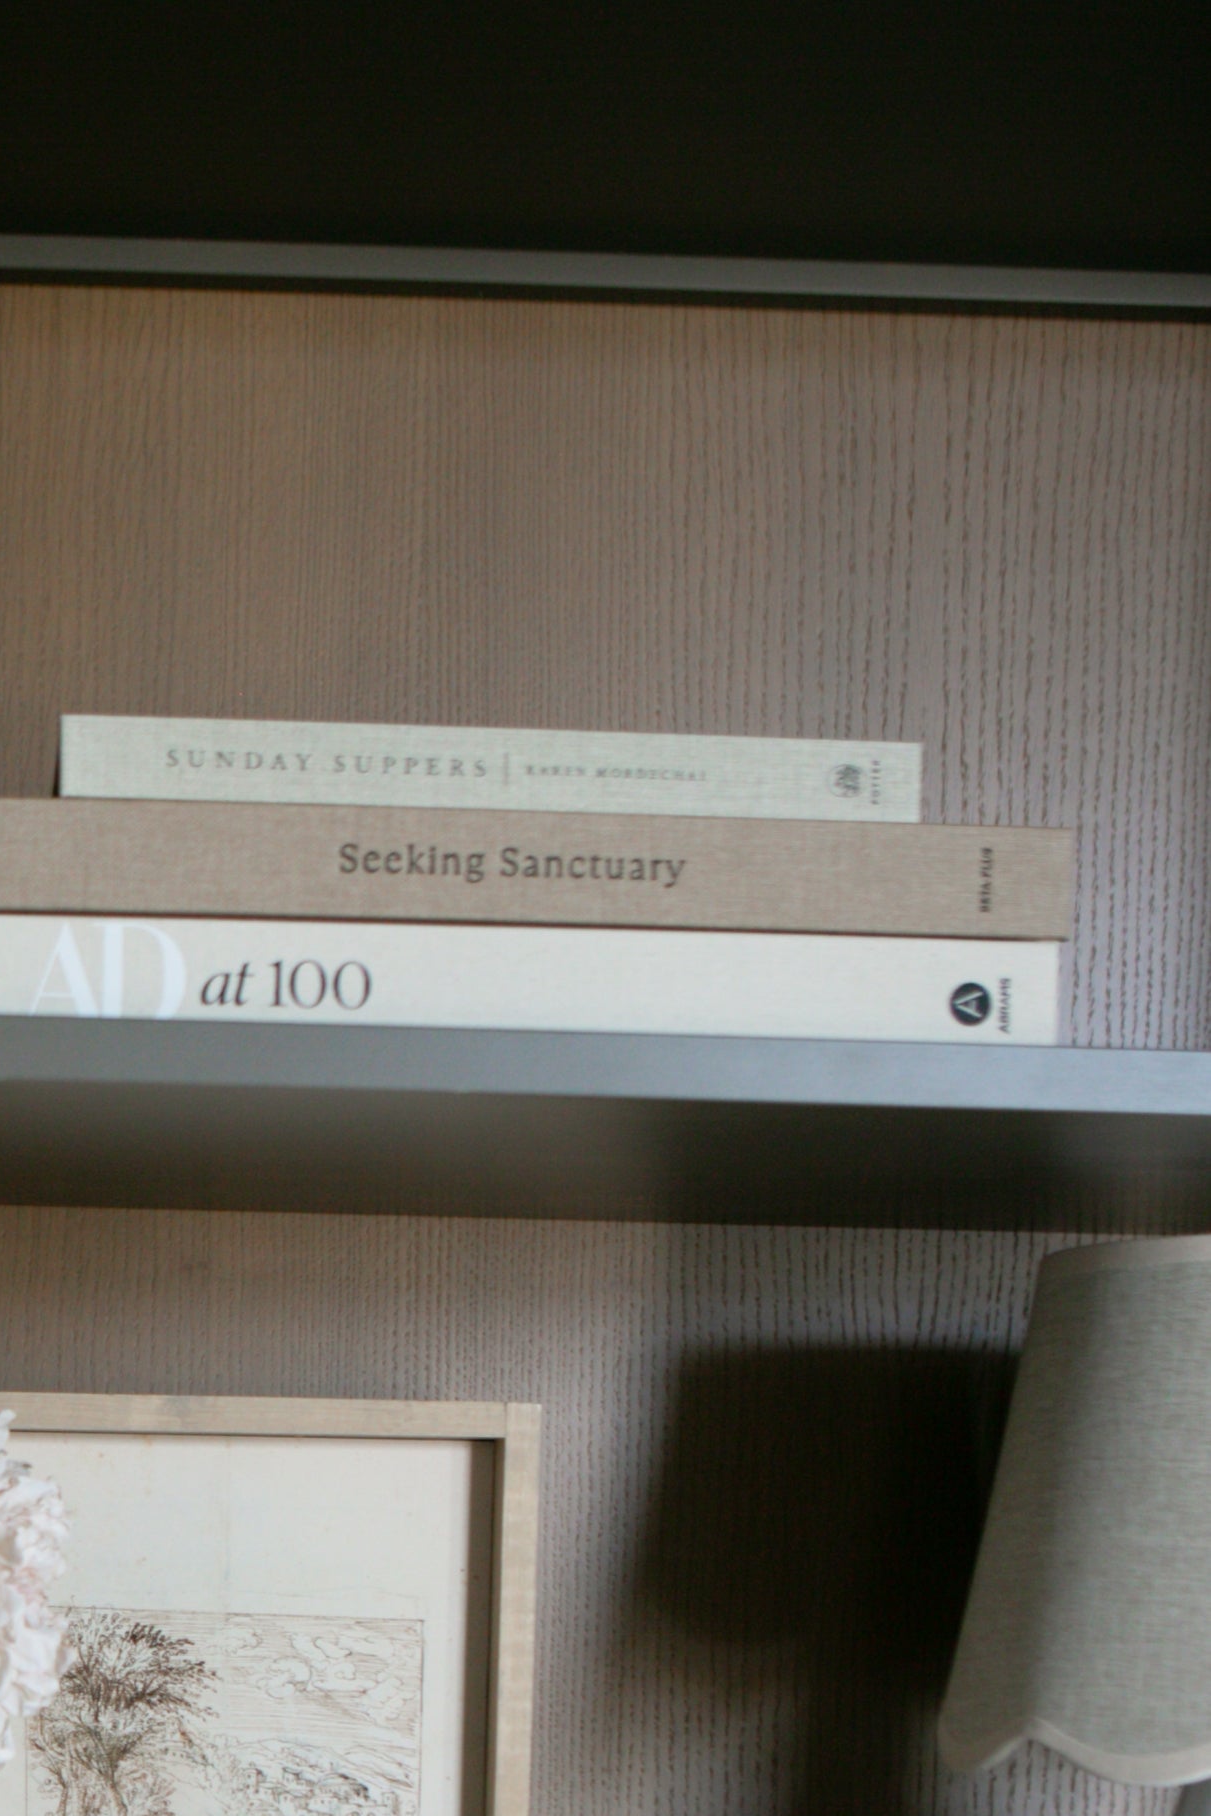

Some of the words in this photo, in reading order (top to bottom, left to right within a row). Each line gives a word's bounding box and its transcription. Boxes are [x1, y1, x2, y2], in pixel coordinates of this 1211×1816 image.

[165, 749, 313, 772] SUNDAY
[333, 755, 489, 779] SUPPERS
[339, 843, 485, 884] Seeking
[499, 847, 686, 888] Sanctuary
[29, 921, 186, 1020] AD
[200, 961, 254, 1007] at
[270, 960, 372, 1011] 100
